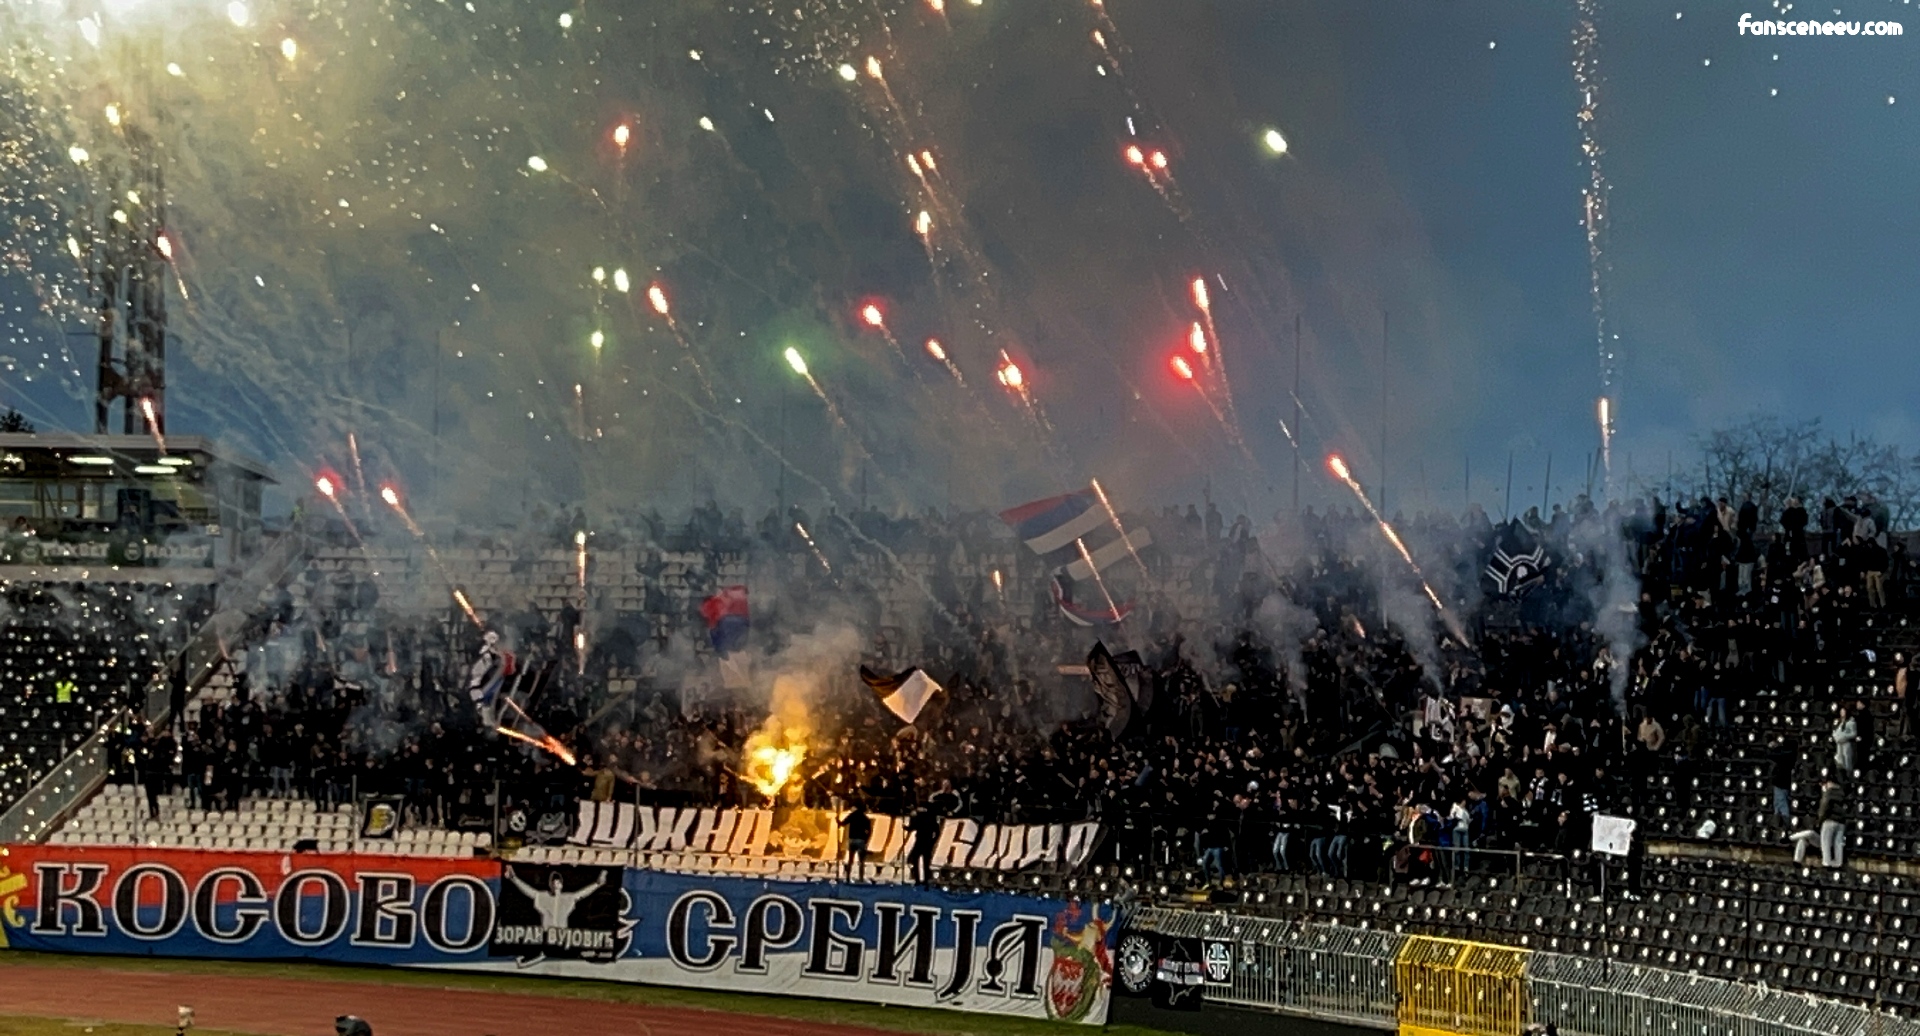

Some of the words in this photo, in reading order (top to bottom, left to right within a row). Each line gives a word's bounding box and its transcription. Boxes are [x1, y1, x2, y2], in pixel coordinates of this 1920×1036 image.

[31, 862, 497, 953] КОСОВО
[666, 889, 1048, 1000] СРБИЈА
[494, 926, 544, 944] ЗОРАН
